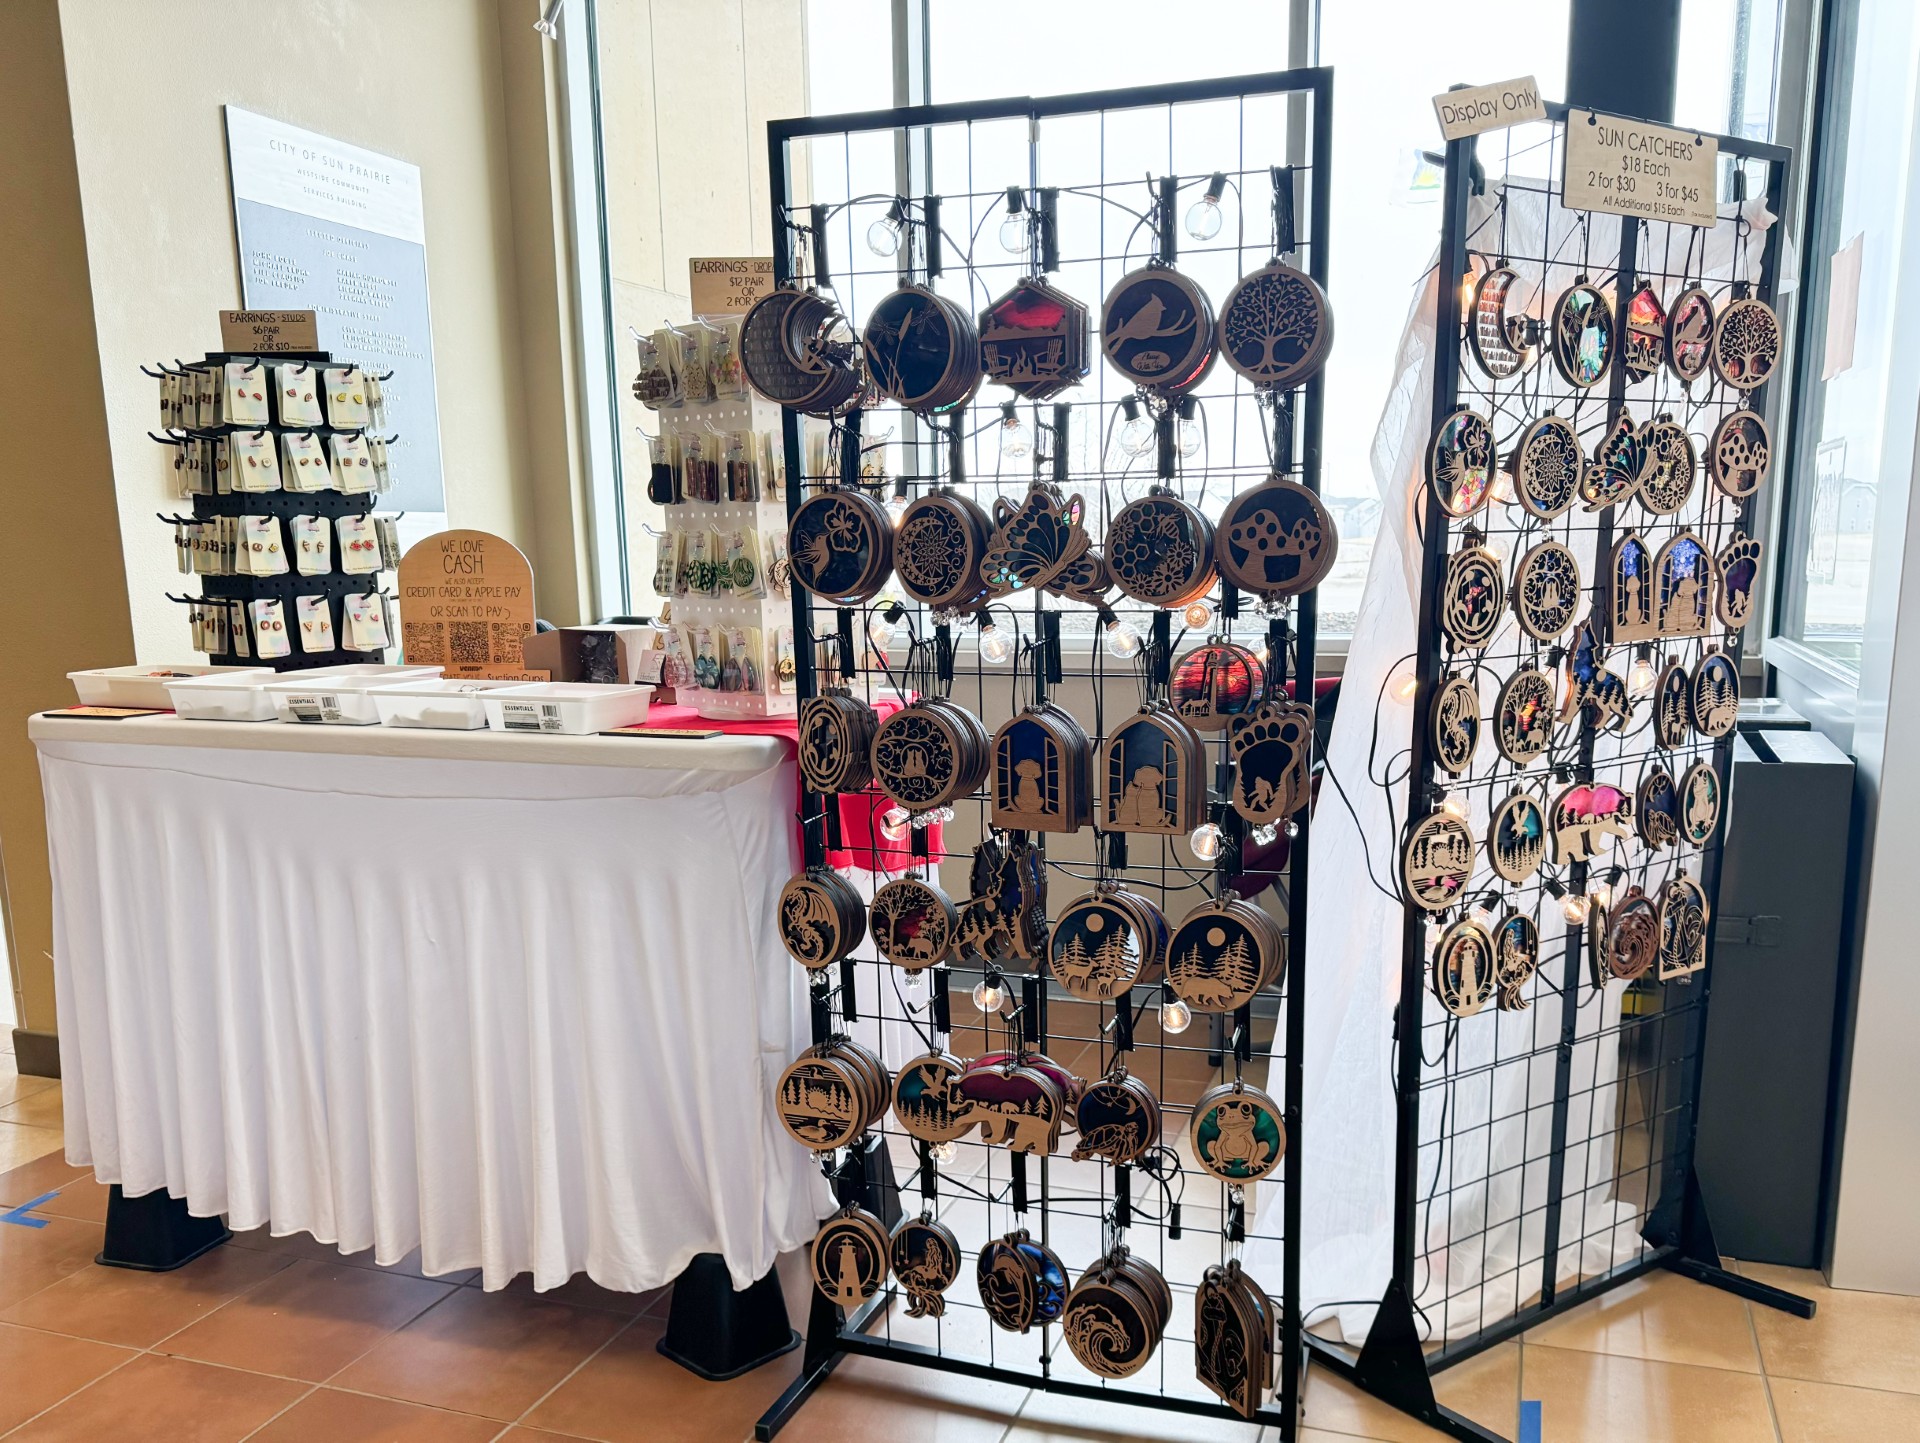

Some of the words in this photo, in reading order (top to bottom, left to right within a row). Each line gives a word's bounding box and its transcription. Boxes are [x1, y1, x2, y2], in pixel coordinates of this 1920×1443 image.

[1441, 98, 1498, 125] Display
[1502, 88, 1537, 111] Only
[1597, 126, 1624, 148] SUN
[1627, 132, 1693, 161] CATCHERS
[269, 139, 296, 156] CITY
[302, 149, 317, 162] OF
[322, 155, 344, 171] SUN
[349, 163, 391, 185] PRAIRIE
[1621, 154, 1641, 174] $18
[1643, 158, 1671, 178] Each
[332, 177, 370, 194] COMMUNITY
[1588, 170, 1596, 187] 2
[1598, 171, 1614, 189] for
[1616, 174, 1636, 194] $30
[303, 186, 334, 201] SERVICES
[1656, 181, 1663, 197] 3
[1665, 182, 1680, 199] for
[1681, 185, 1699, 204] $45
[1602, 196, 1613, 207] All
[1614, 197, 1653, 212] Additional
[1653, 202, 1666, 215] $15
[1667, 204, 1685, 216] Each
[729, 276, 743, 287] $12
[741, 286, 755, 297] OR
[726, 297, 733, 307] 2
[734, 296, 752, 306] FOR
[281, 313, 306, 322] STUDS
[252, 325, 263, 335] $6
[262, 334, 274, 343] OR
[253, 343, 258, 351] 2
[260, 342, 274, 351] FOR
[275, 342, 290, 351] $10
[440, 539, 456, 553] WE
[459, 539, 485, 553] LOVE
[443, 554, 484, 575] CASH
[445, 577, 453, 585] WE
[406, 586, 436, 598] CREDIT
[438, 586, 462, 598] CARD
[465, 586, 472, 598] &
[474, 586, 501, 598] APPLE
[504, 586, 522, 598] PAY
[430, 605, 443, 618] OR
[445, 605, 469, 618] SCAN
[472, 605, 483, 618] TO
[486, 605, 503, 618] PAY
